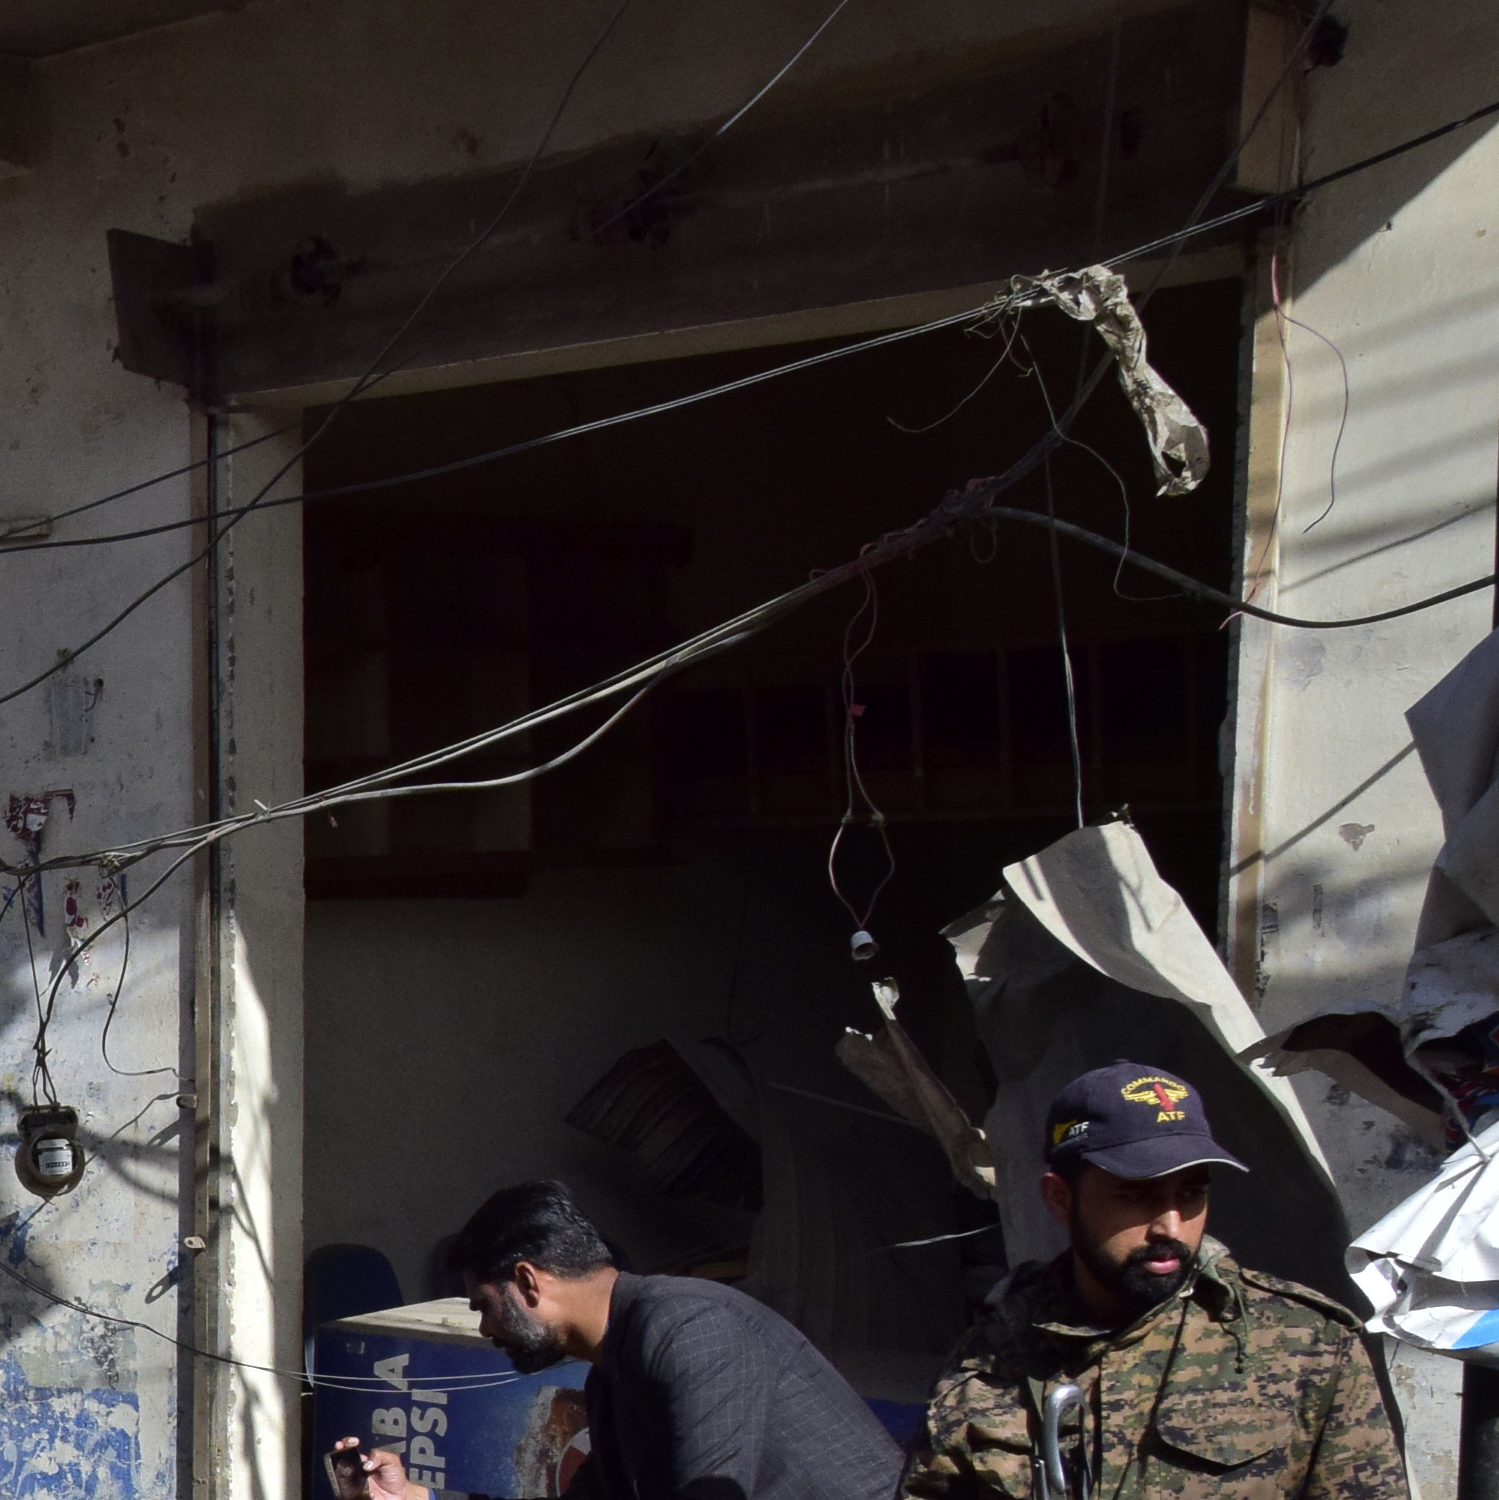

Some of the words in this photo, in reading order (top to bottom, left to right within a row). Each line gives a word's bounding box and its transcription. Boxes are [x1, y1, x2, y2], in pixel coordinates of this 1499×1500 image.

[1121, 1076, 1187, 1096] COMMANDO
[1156, 1110, 1186, 1123] ATF
[1068, 1121, 1090, 1137] ATF
[373, 1353, 410, 1392] A
[409, 1388, 448, 1490] EPSI
